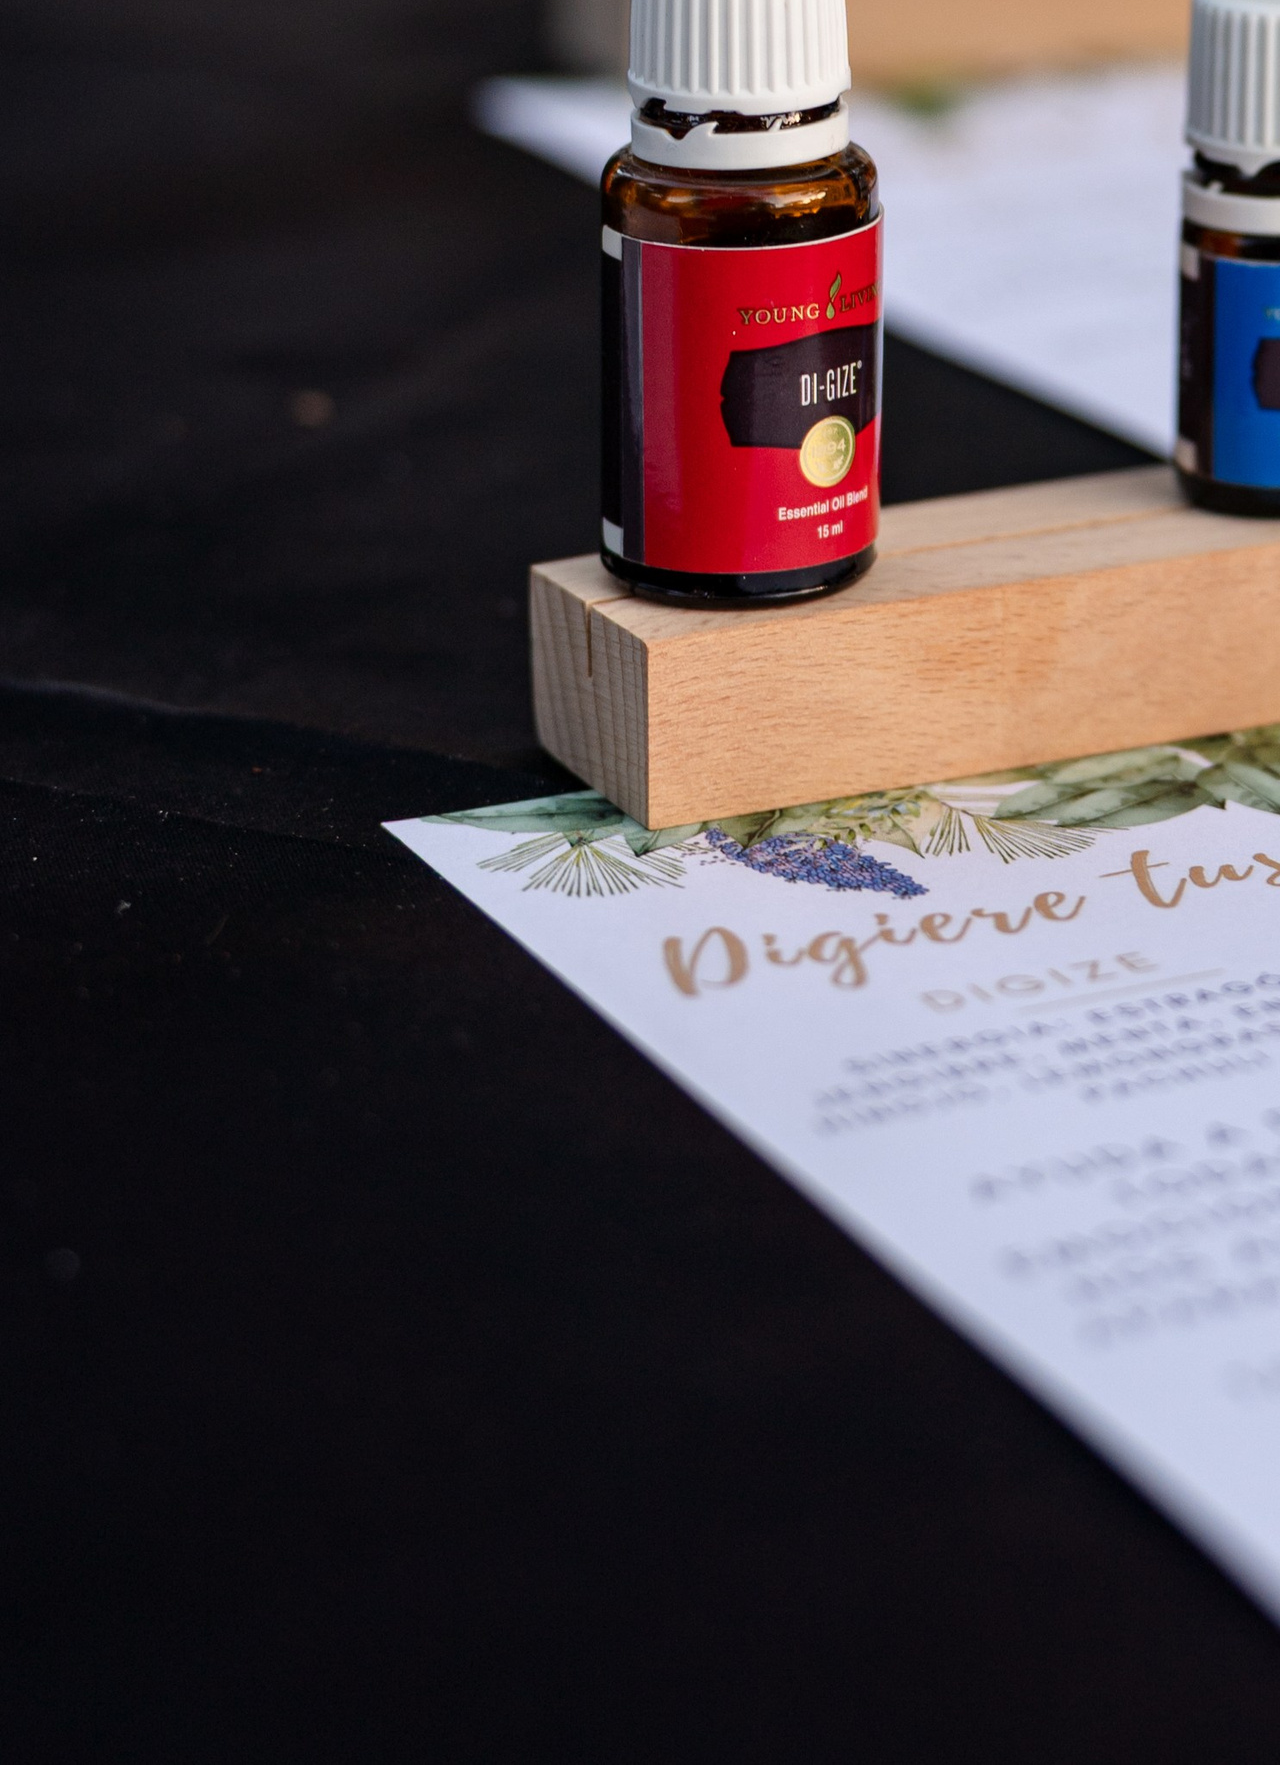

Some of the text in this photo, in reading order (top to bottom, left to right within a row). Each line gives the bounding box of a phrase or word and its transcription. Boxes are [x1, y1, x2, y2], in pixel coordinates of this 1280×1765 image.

[737, 281, 881, 325] YOUNG LIVIN
[778, 485, 868, 521] Essential Oil Blend
[817, 519, 843, 539] 15 ml
[662, 889, 1086, 998] Digiere
[919, 950, 1160, 1013] DIGIZE
